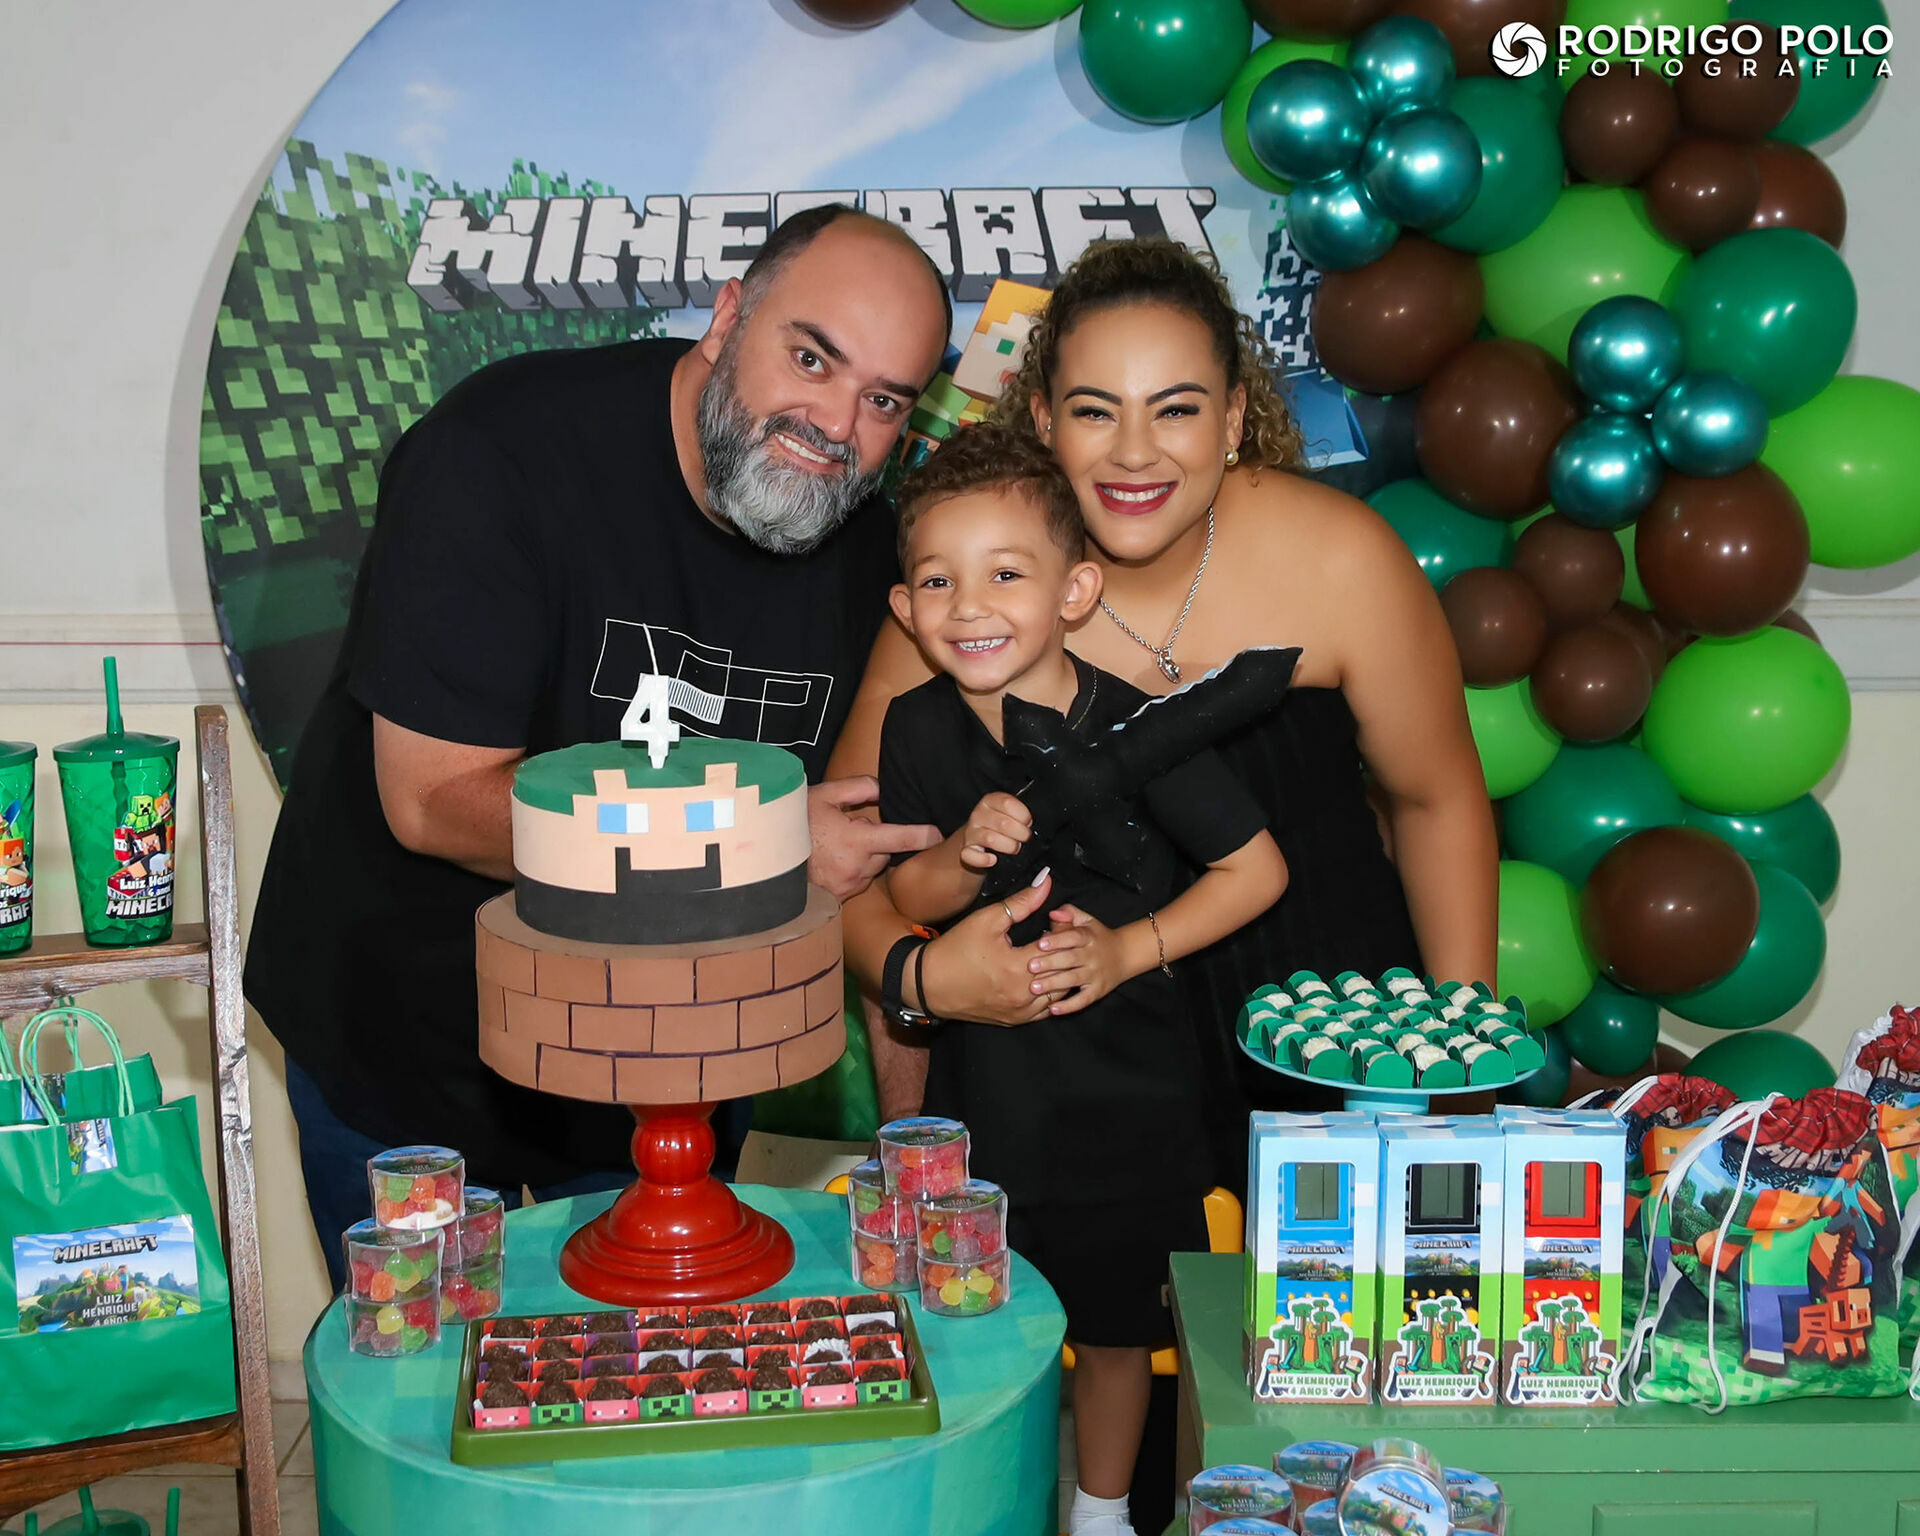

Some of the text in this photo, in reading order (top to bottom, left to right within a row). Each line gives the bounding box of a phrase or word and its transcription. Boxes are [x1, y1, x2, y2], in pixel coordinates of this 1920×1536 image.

[620, 672, 680, 769] 4
[120, 878, 146, 890] Luiz
[53, 1234, 158, 1264] MINECRAFT
[96, 1294, 123, 1306] LUIZ
[82, 1302, 138, 1319] HENRIQUE
[103, 1315, 129, 1326] ANOS
[1270, 1375, 1350, 1386] LUIZ HENRIQUE
[1398, 1377, 1477, 1388] LUIZ HENRIQUE
[1520, 1379, 1599, 1389] LUIZ HENRIQUE
[1290, 1387, 1328, 1396] 4 ANOS
[1418, 1388, 1456, 1397] 4 ANOS
[1540, 1390, 1578, 1399] 4 ANOS
